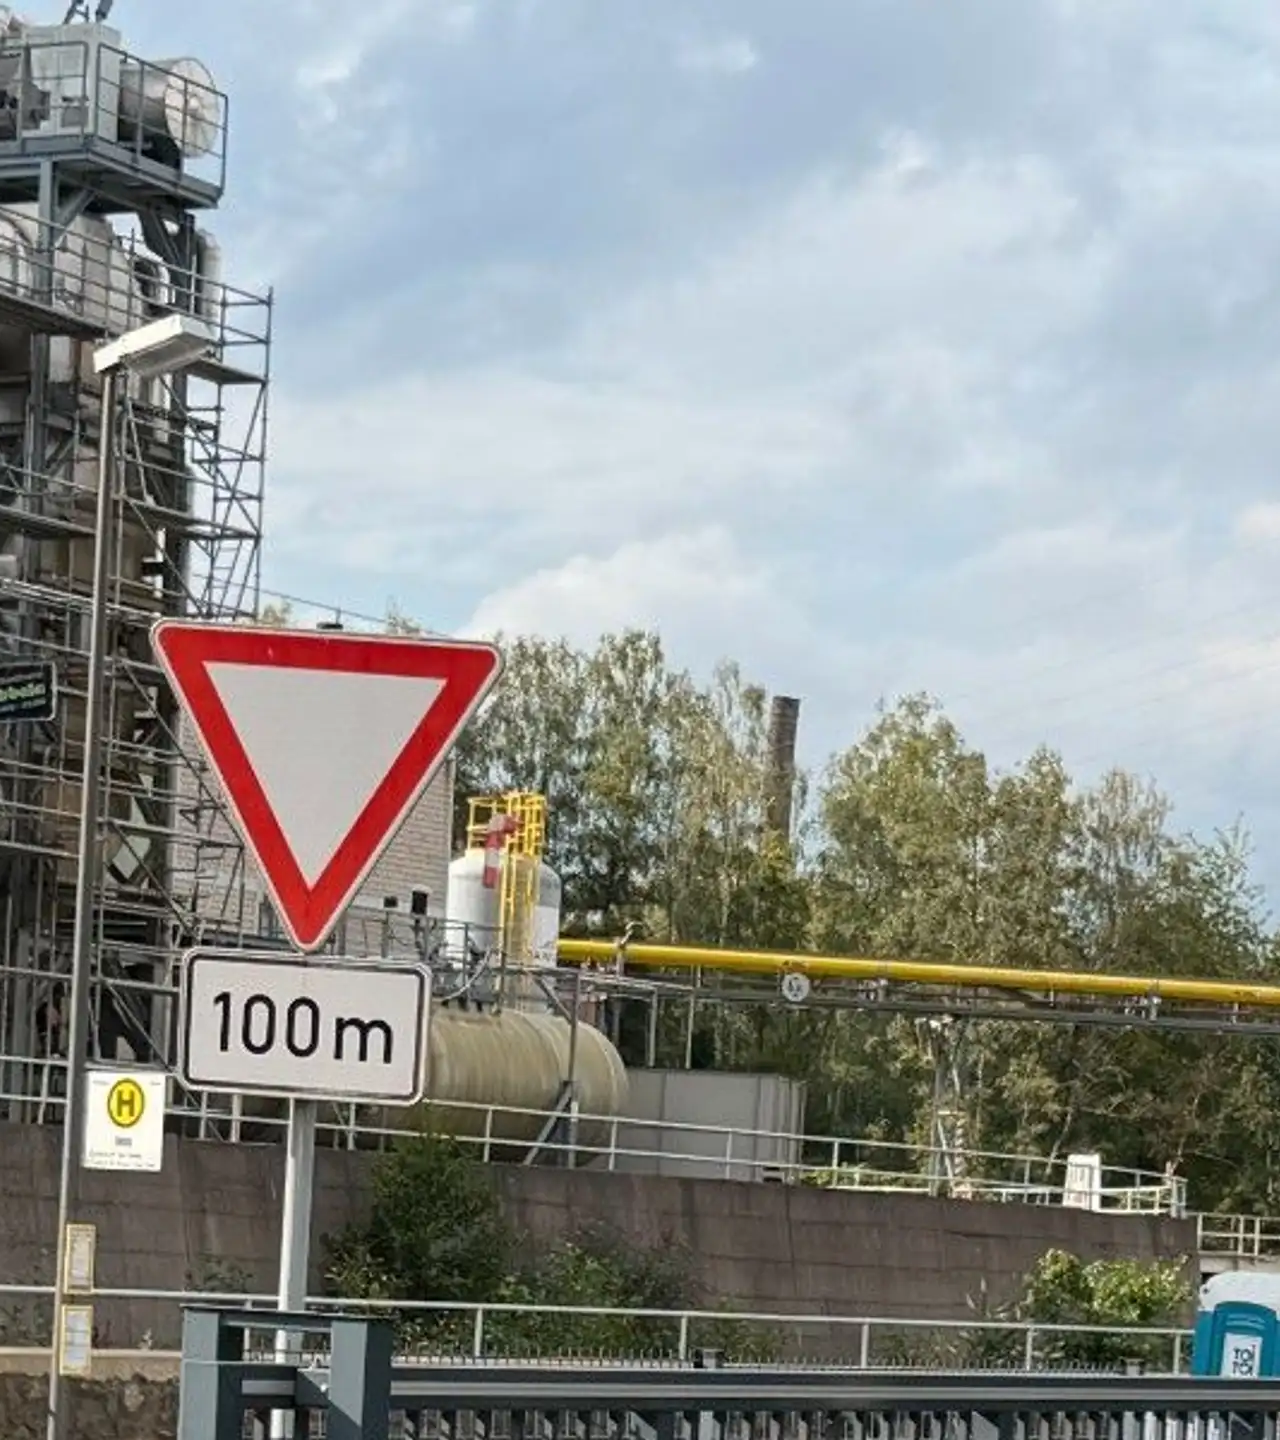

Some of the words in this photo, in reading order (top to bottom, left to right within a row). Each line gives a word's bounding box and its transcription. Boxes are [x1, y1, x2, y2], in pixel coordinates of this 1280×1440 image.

[213, 991, 320, 1058] 100
[333, 1017, 393, 1064] m
[117, 1089, 135, 1117] H
